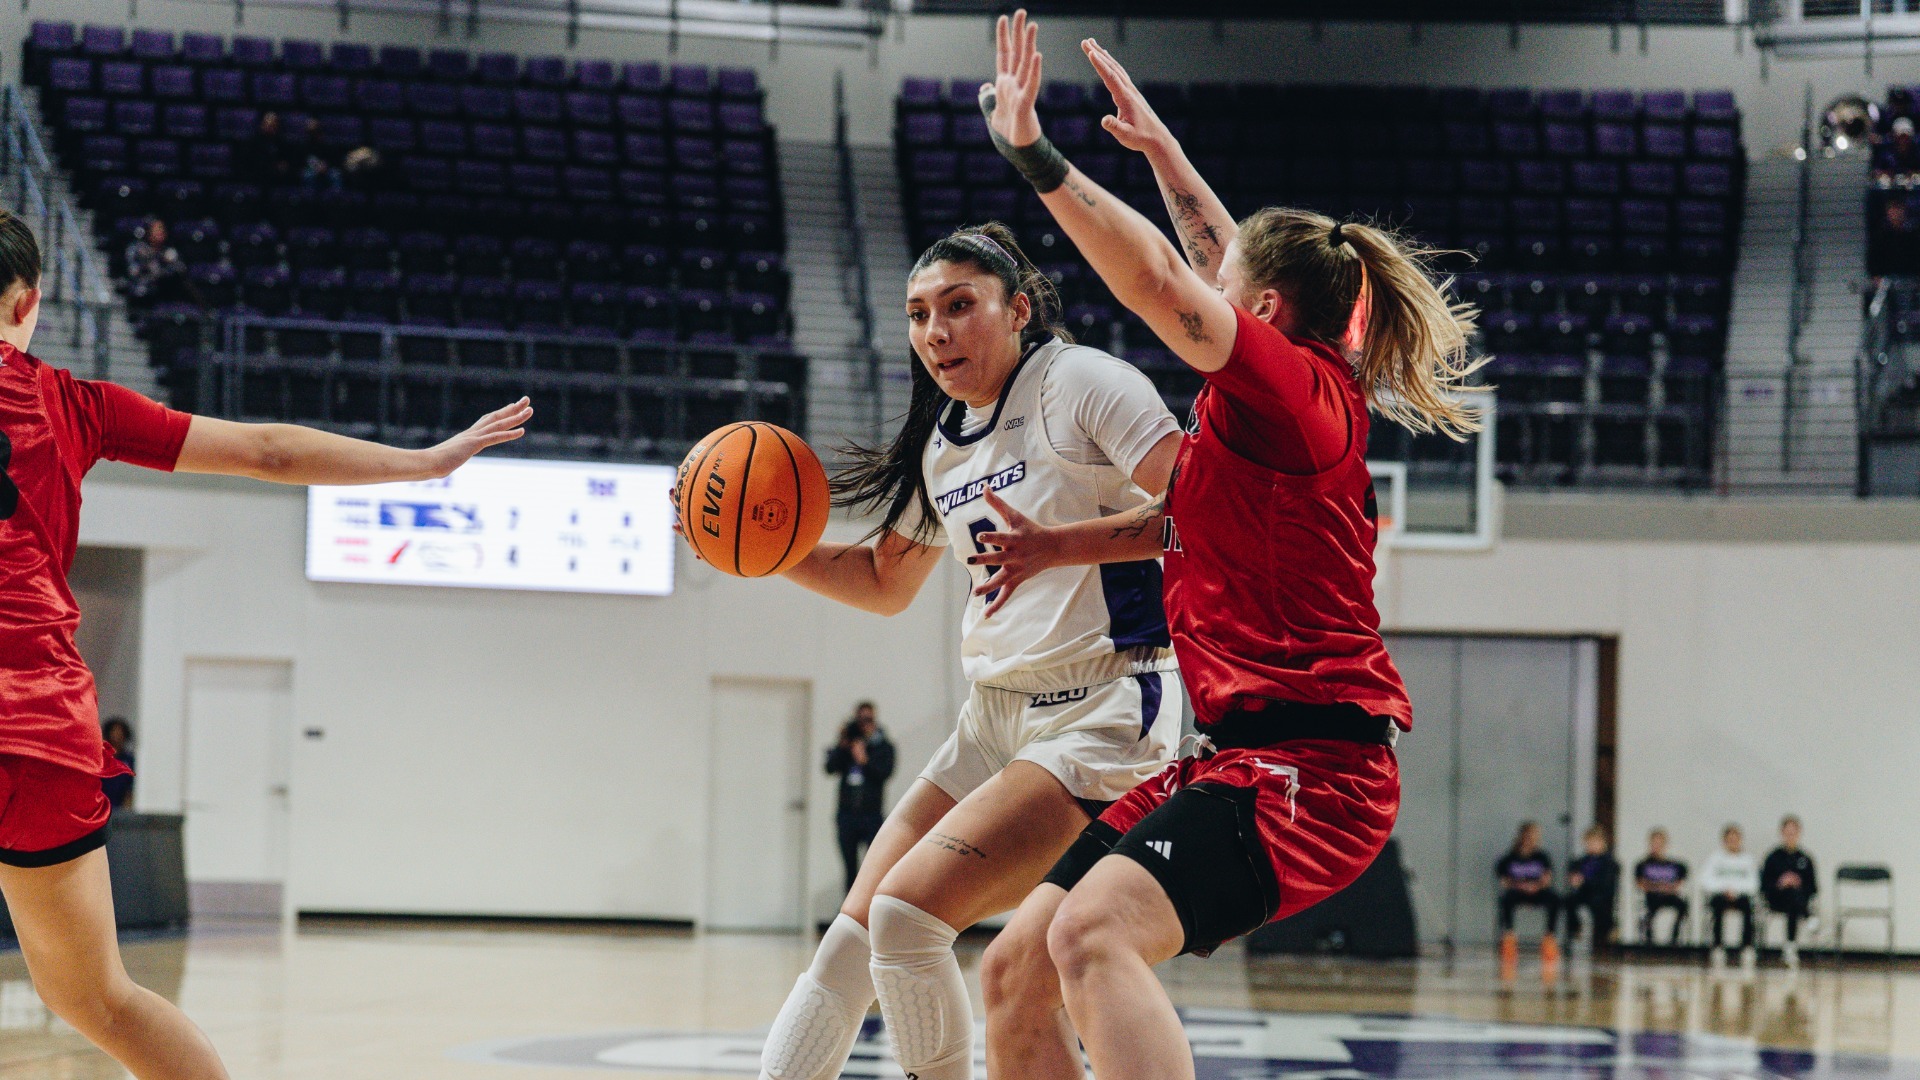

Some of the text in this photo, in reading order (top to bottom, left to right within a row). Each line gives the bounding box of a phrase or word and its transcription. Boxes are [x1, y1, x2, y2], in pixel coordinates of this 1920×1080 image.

[1004, 416, 1025, 430] WAC
[702, 471, 726, 539] EVO
[1029, 687, 1089, 708] ACU
